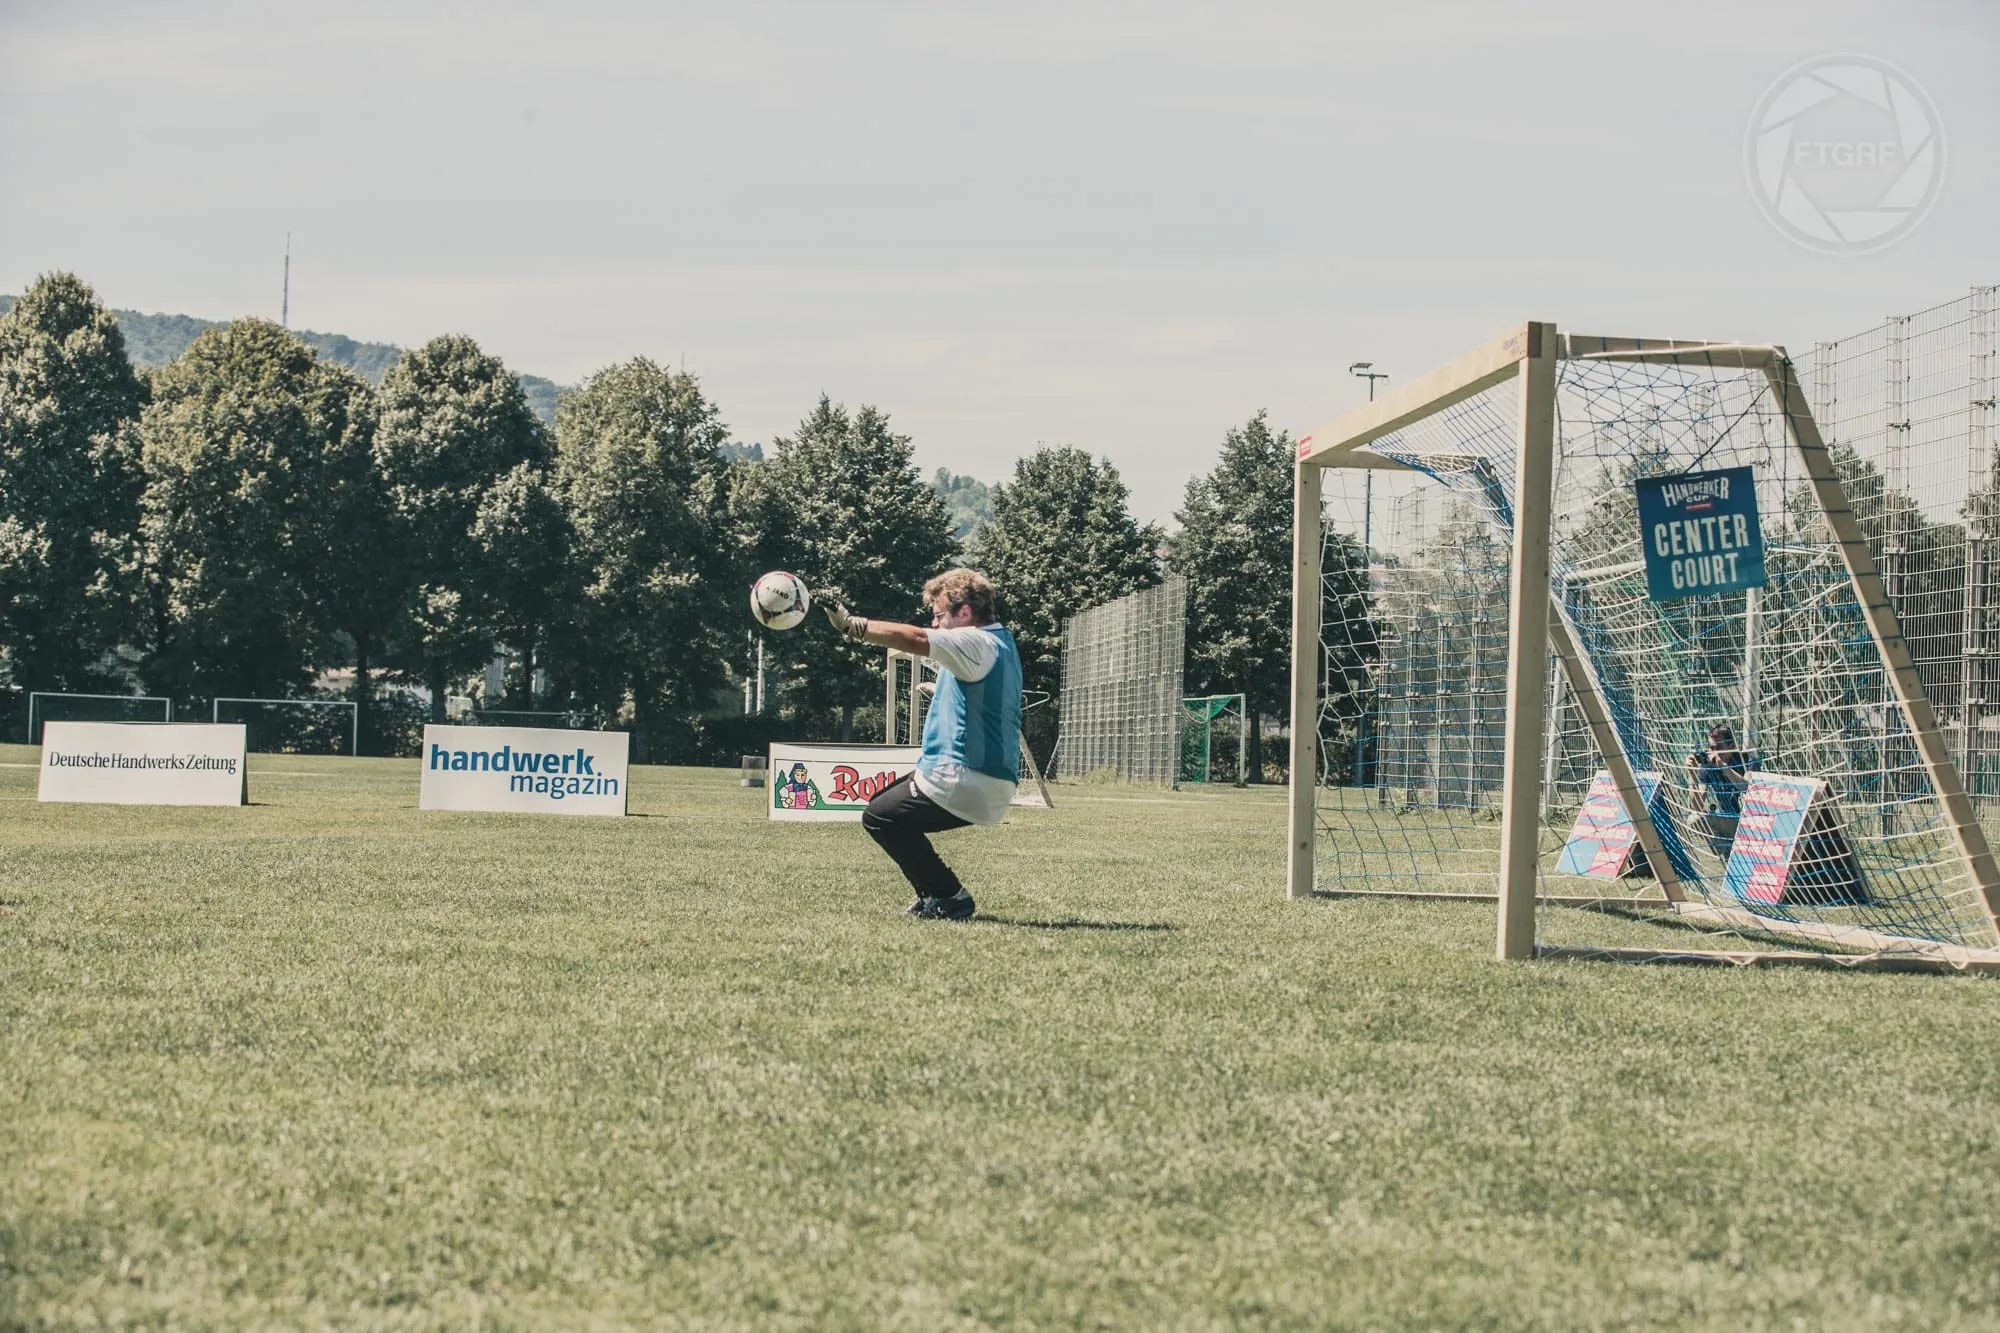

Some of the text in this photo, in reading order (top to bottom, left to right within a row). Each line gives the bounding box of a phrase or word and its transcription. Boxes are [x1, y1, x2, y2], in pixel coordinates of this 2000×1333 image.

[1685, 494, 1710, 503] CUP
[1654, 513, 1750, 557] CENTER
[1671, 552, 1739, 589] COURT
[430, 743, 595, 775] handwerk
[510, 771, 619, 800] magazin
